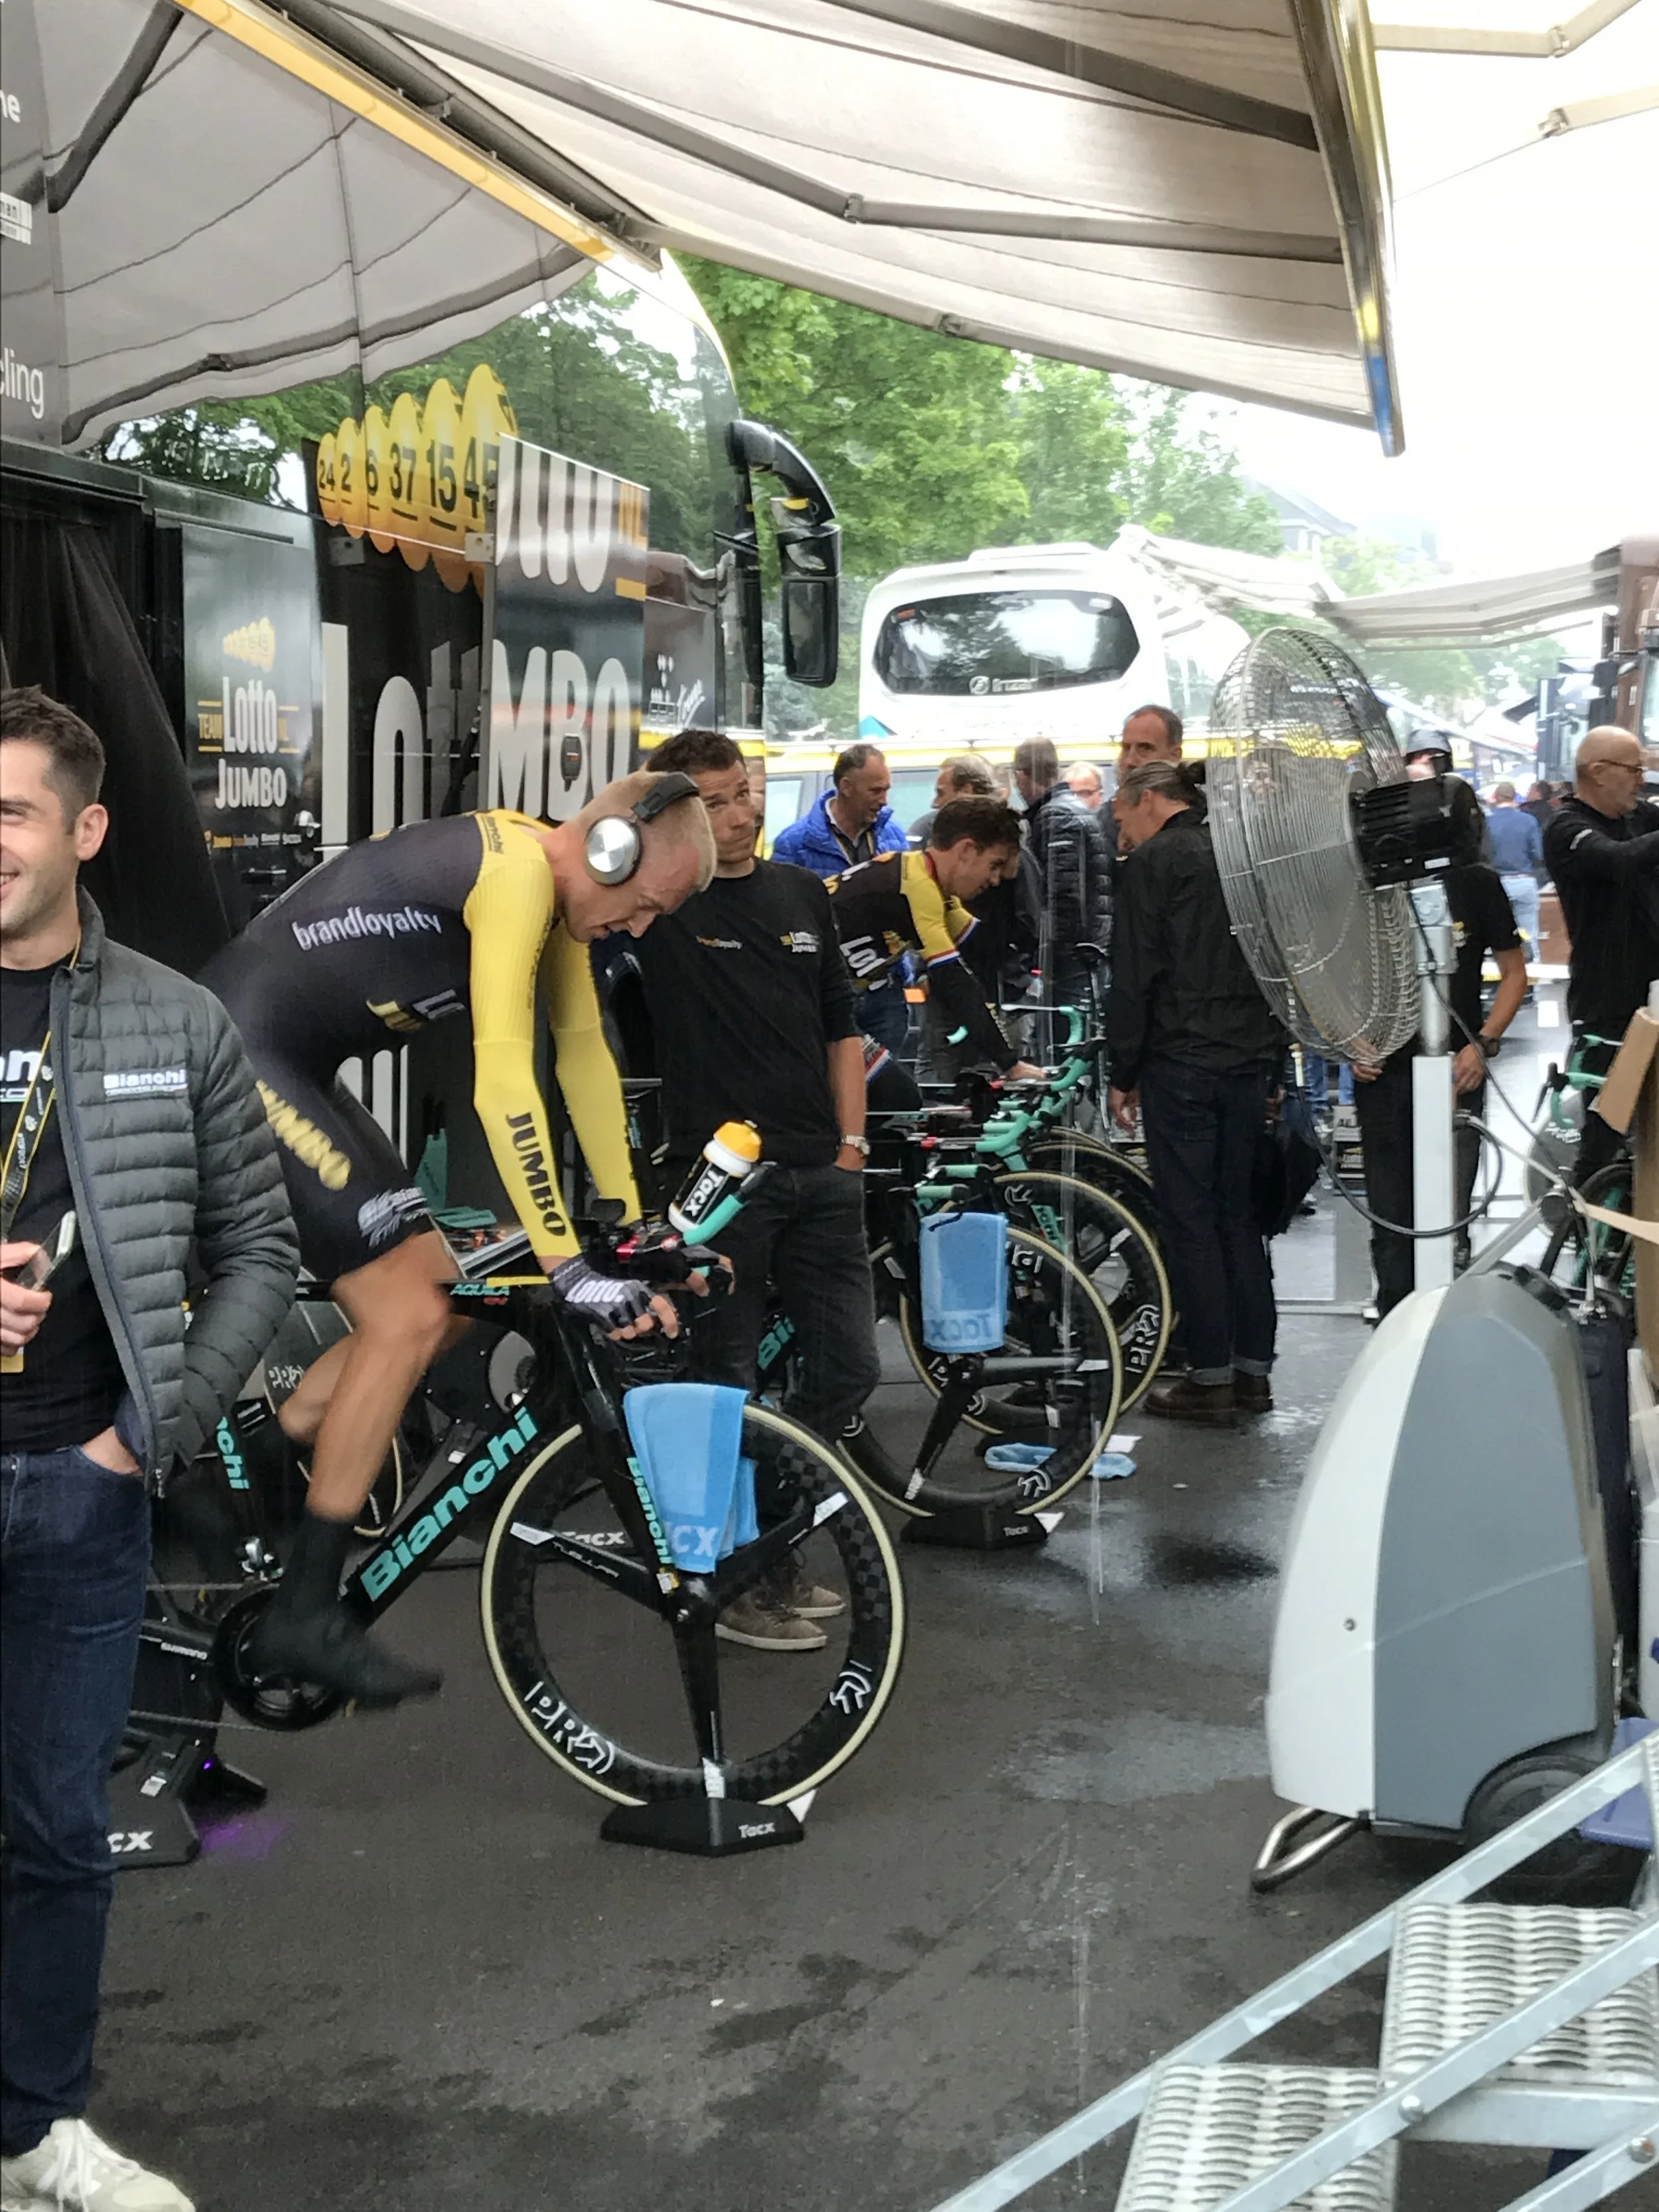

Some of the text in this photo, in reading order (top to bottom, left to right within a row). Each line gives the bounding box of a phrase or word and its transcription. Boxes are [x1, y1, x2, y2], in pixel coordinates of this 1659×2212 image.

[319, 459, 335, 492] 24
[340, 453, 352, 492] 2
[366, 448, 379, 496] 6
[390, 442, 417, 504] 37
[427, 439, 457, 514] 15
[215, 758, 287, 809] JUMBO
[292, 905, 443, 951] brandloyalty
[104, 1069, 186, 1089] Bianchi
[506, 1111, 567, 1236] JUMBO
[685, 1169, 725, 1217] Tacx
[359, 1405, 540, 1603] Bianchi
[738, 1820, 776, 1839] Tacx
